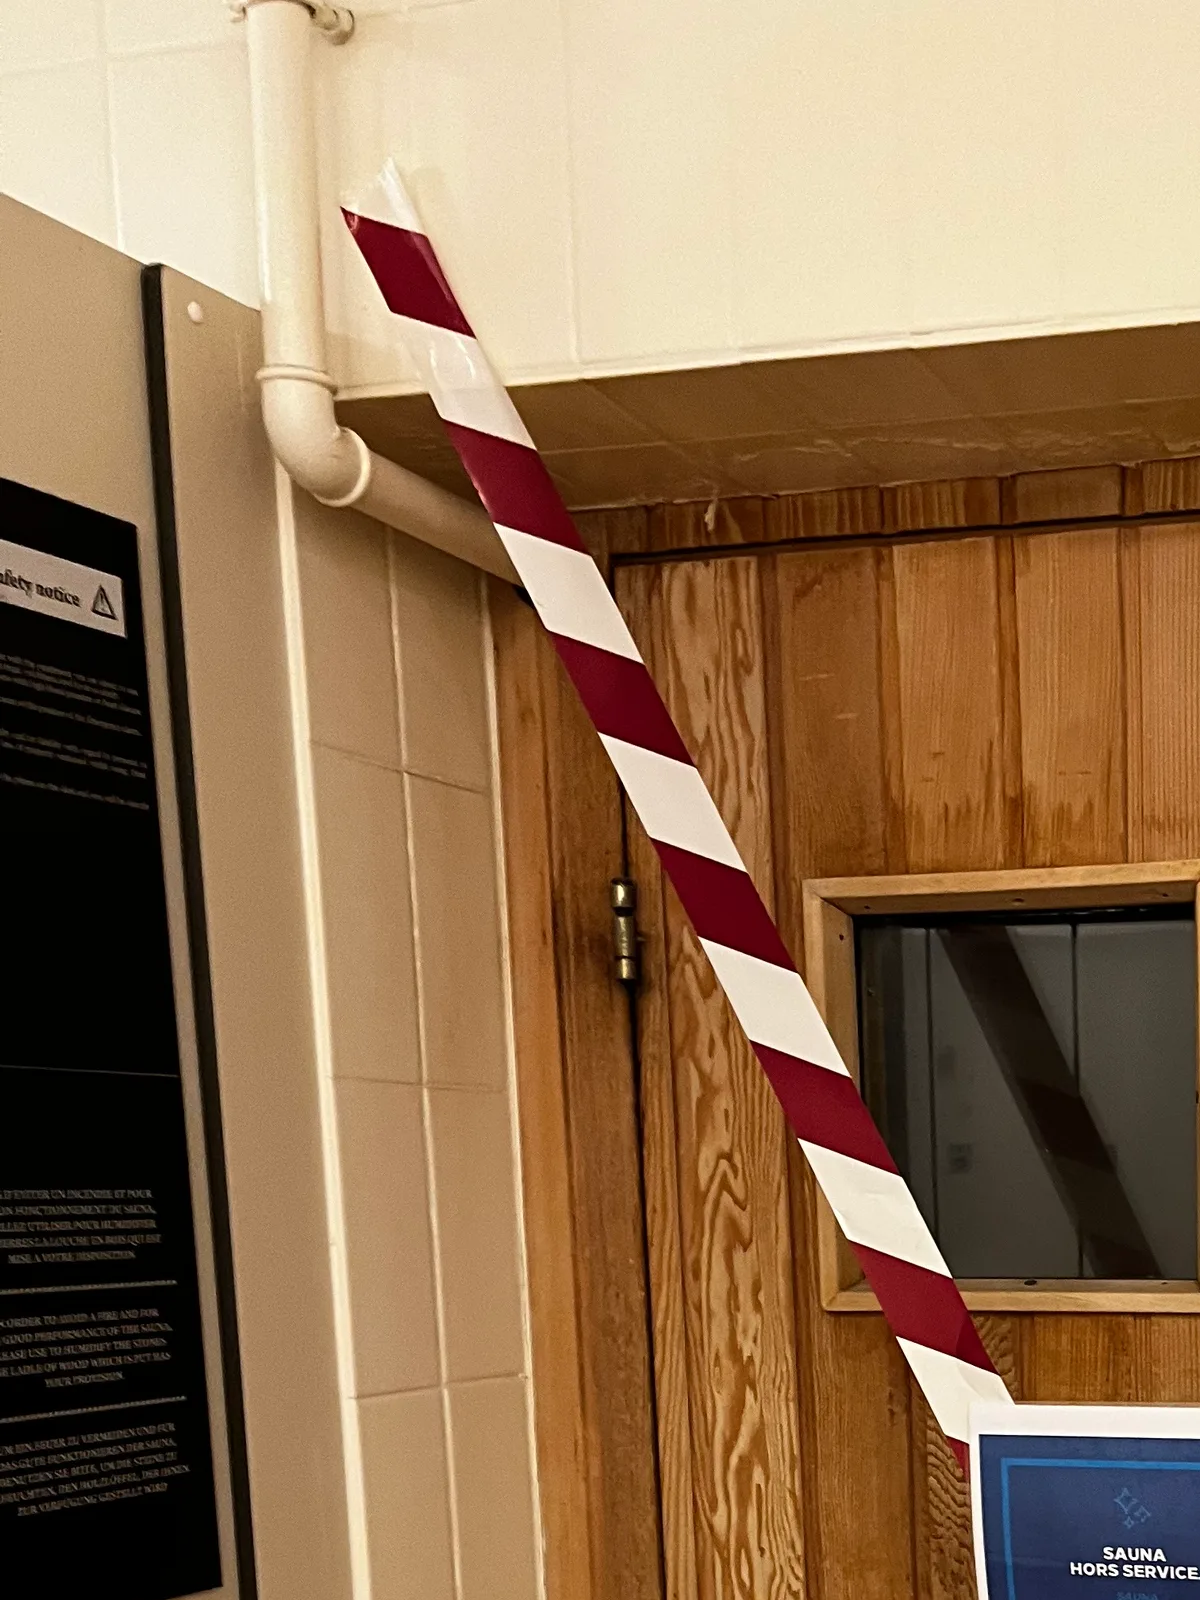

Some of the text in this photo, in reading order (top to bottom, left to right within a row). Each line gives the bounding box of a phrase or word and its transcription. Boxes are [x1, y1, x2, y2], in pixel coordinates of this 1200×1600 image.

[35, 583, 82, 608] notice
[139, 1307, 160, 1318] FOR
[1102, 1546, 1167, 1563] SAUNA
[1069, 1561, 1120, 1578] HORS
